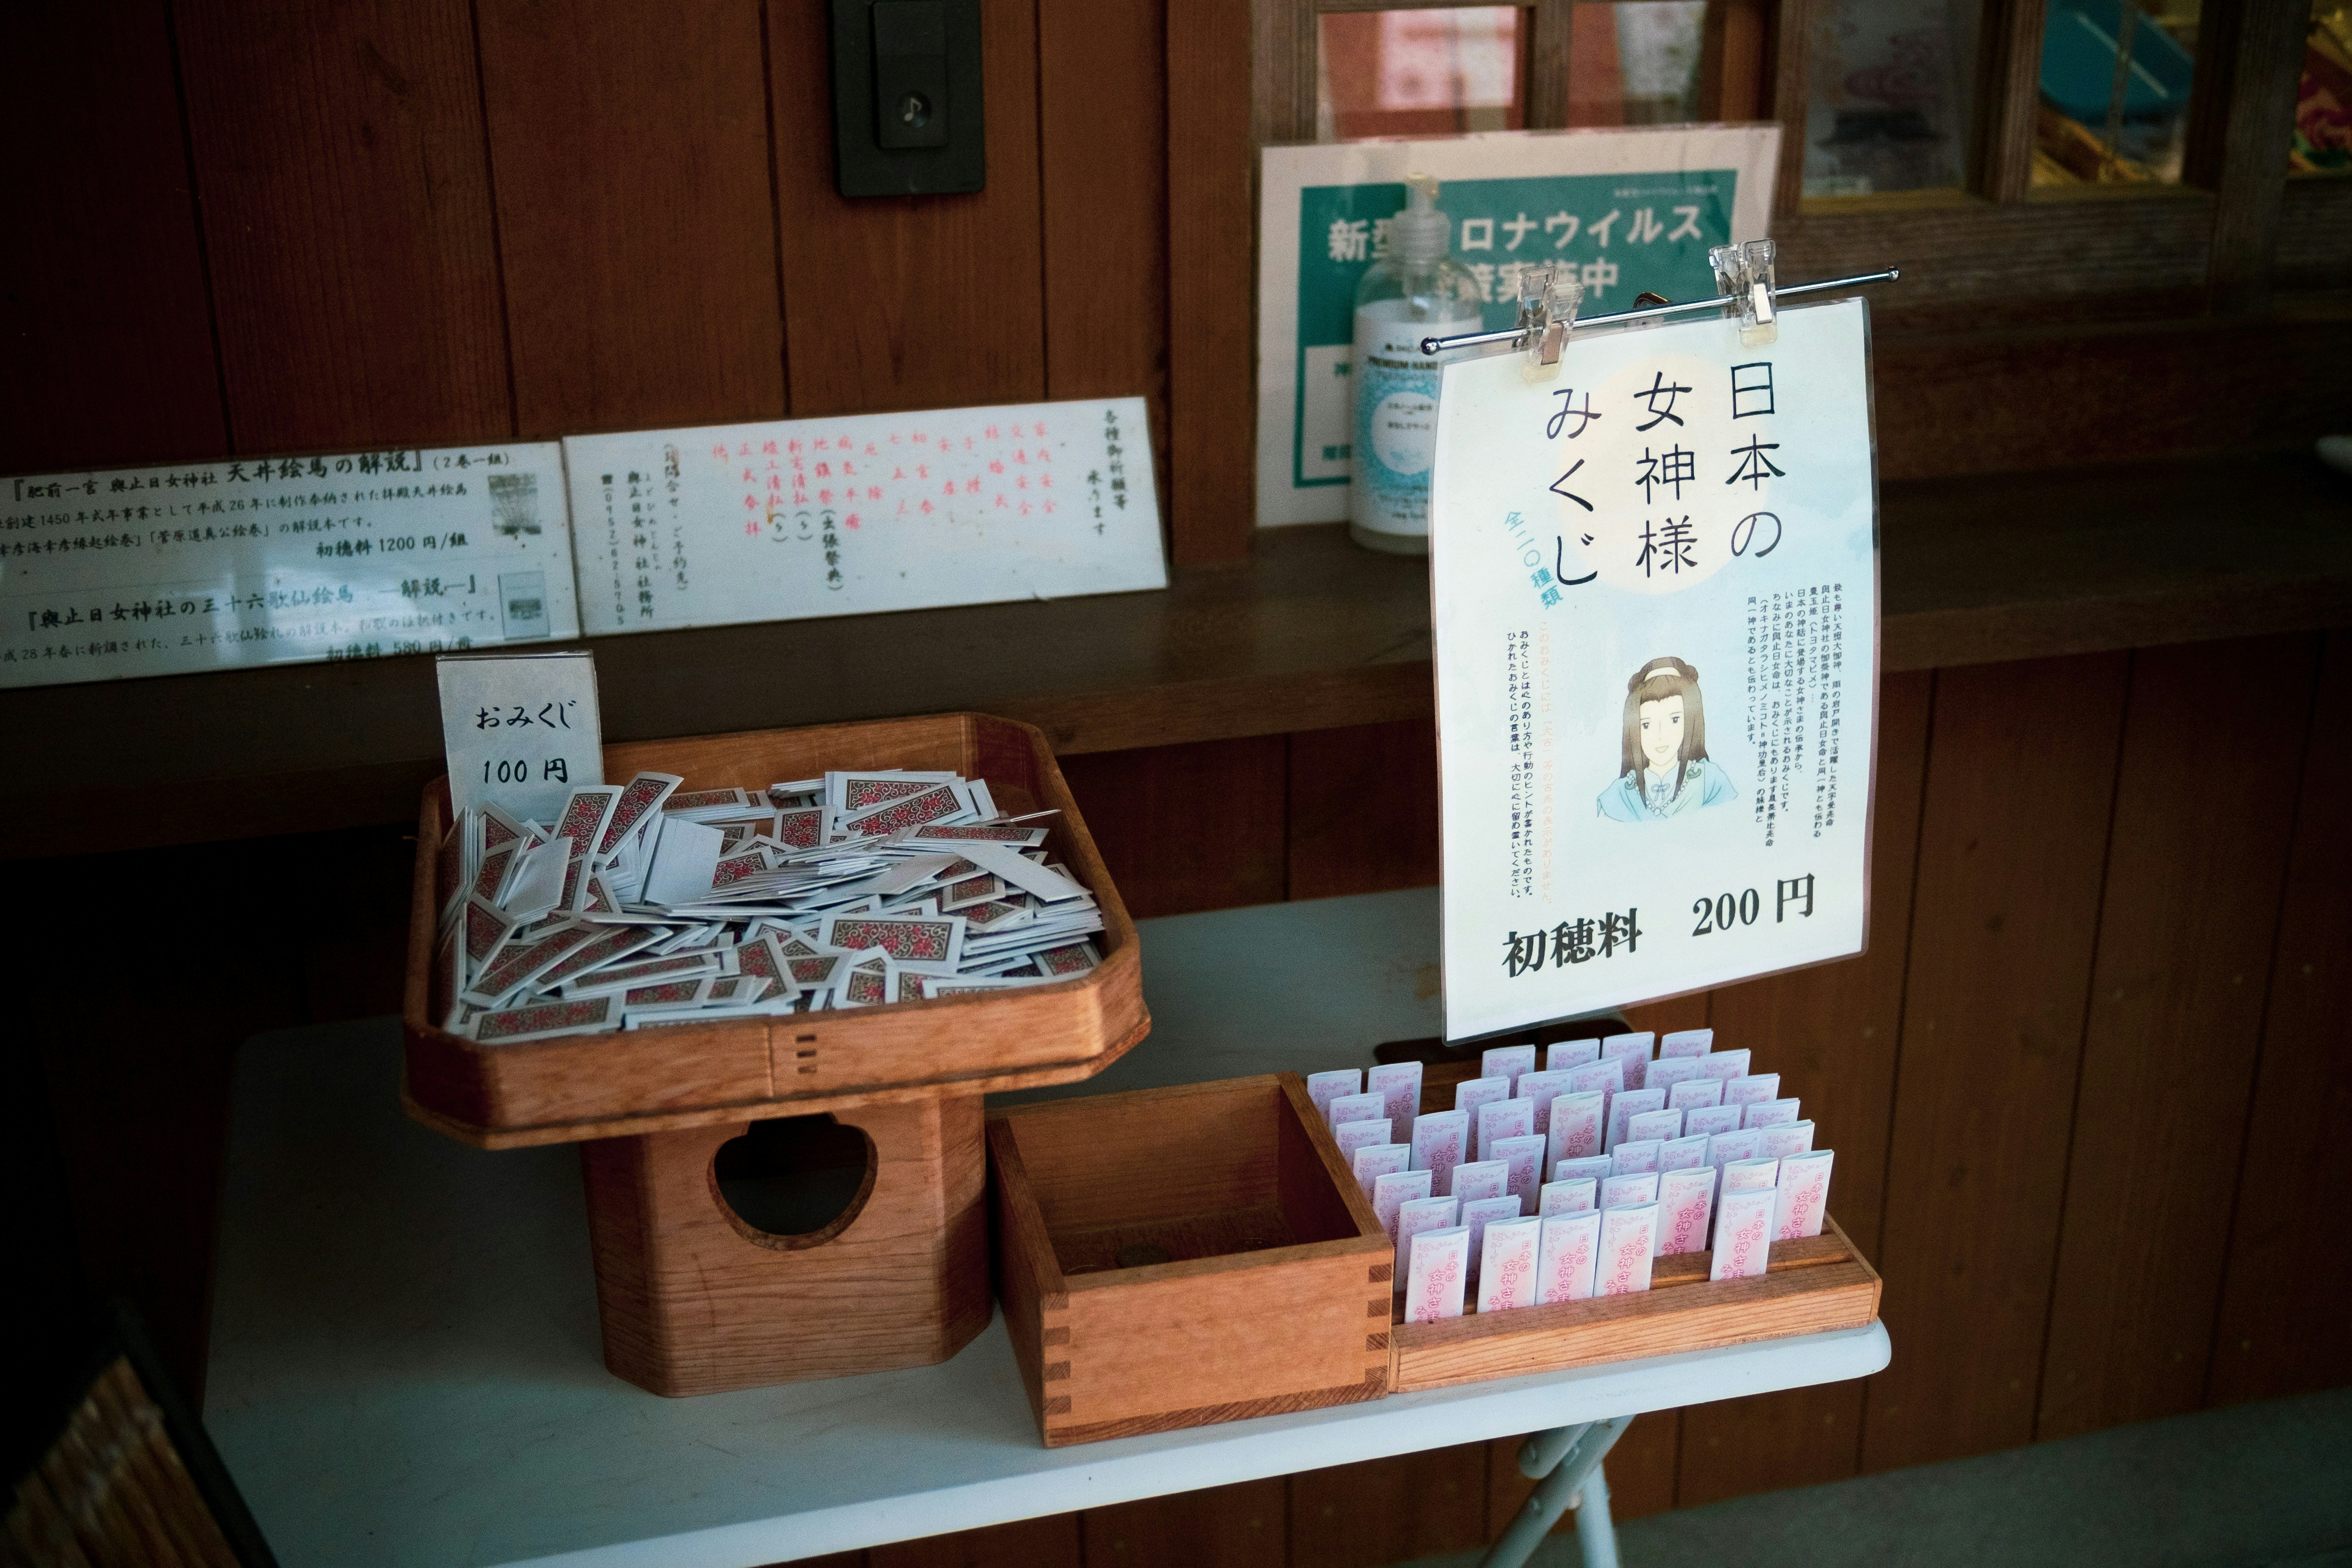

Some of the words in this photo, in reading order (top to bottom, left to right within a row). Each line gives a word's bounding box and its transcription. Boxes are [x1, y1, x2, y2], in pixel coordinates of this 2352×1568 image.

[1633, 371, 1698, 578] 女神様
[1725, 362, 1786, 557] 日本の
[1546, 388, 1602, 586] みくじ
[476, 700, 577, 730] おみくじ
[484, 760, 527, 783] 100
[544, 758, 568, 783] 円
[1502, 908, 1642, 978] 初穂料
[1692, 888, 1759, 937] 200
[1776, 873, 1815, 923] 円
[1811, 1172, 1824, 1202] 日本の
[1694, 1190, 1707, 1220] 日本の
[1636, 1224, 1648, 1256] 日本の
[1752, 1209, 1764, 1241] 日本の
[1519, 1240, 1531, 1271] 日本の
[1577, 1234, 1589, 1264] 日本の
[1446, 1250, 1458, 1281] 日本の
